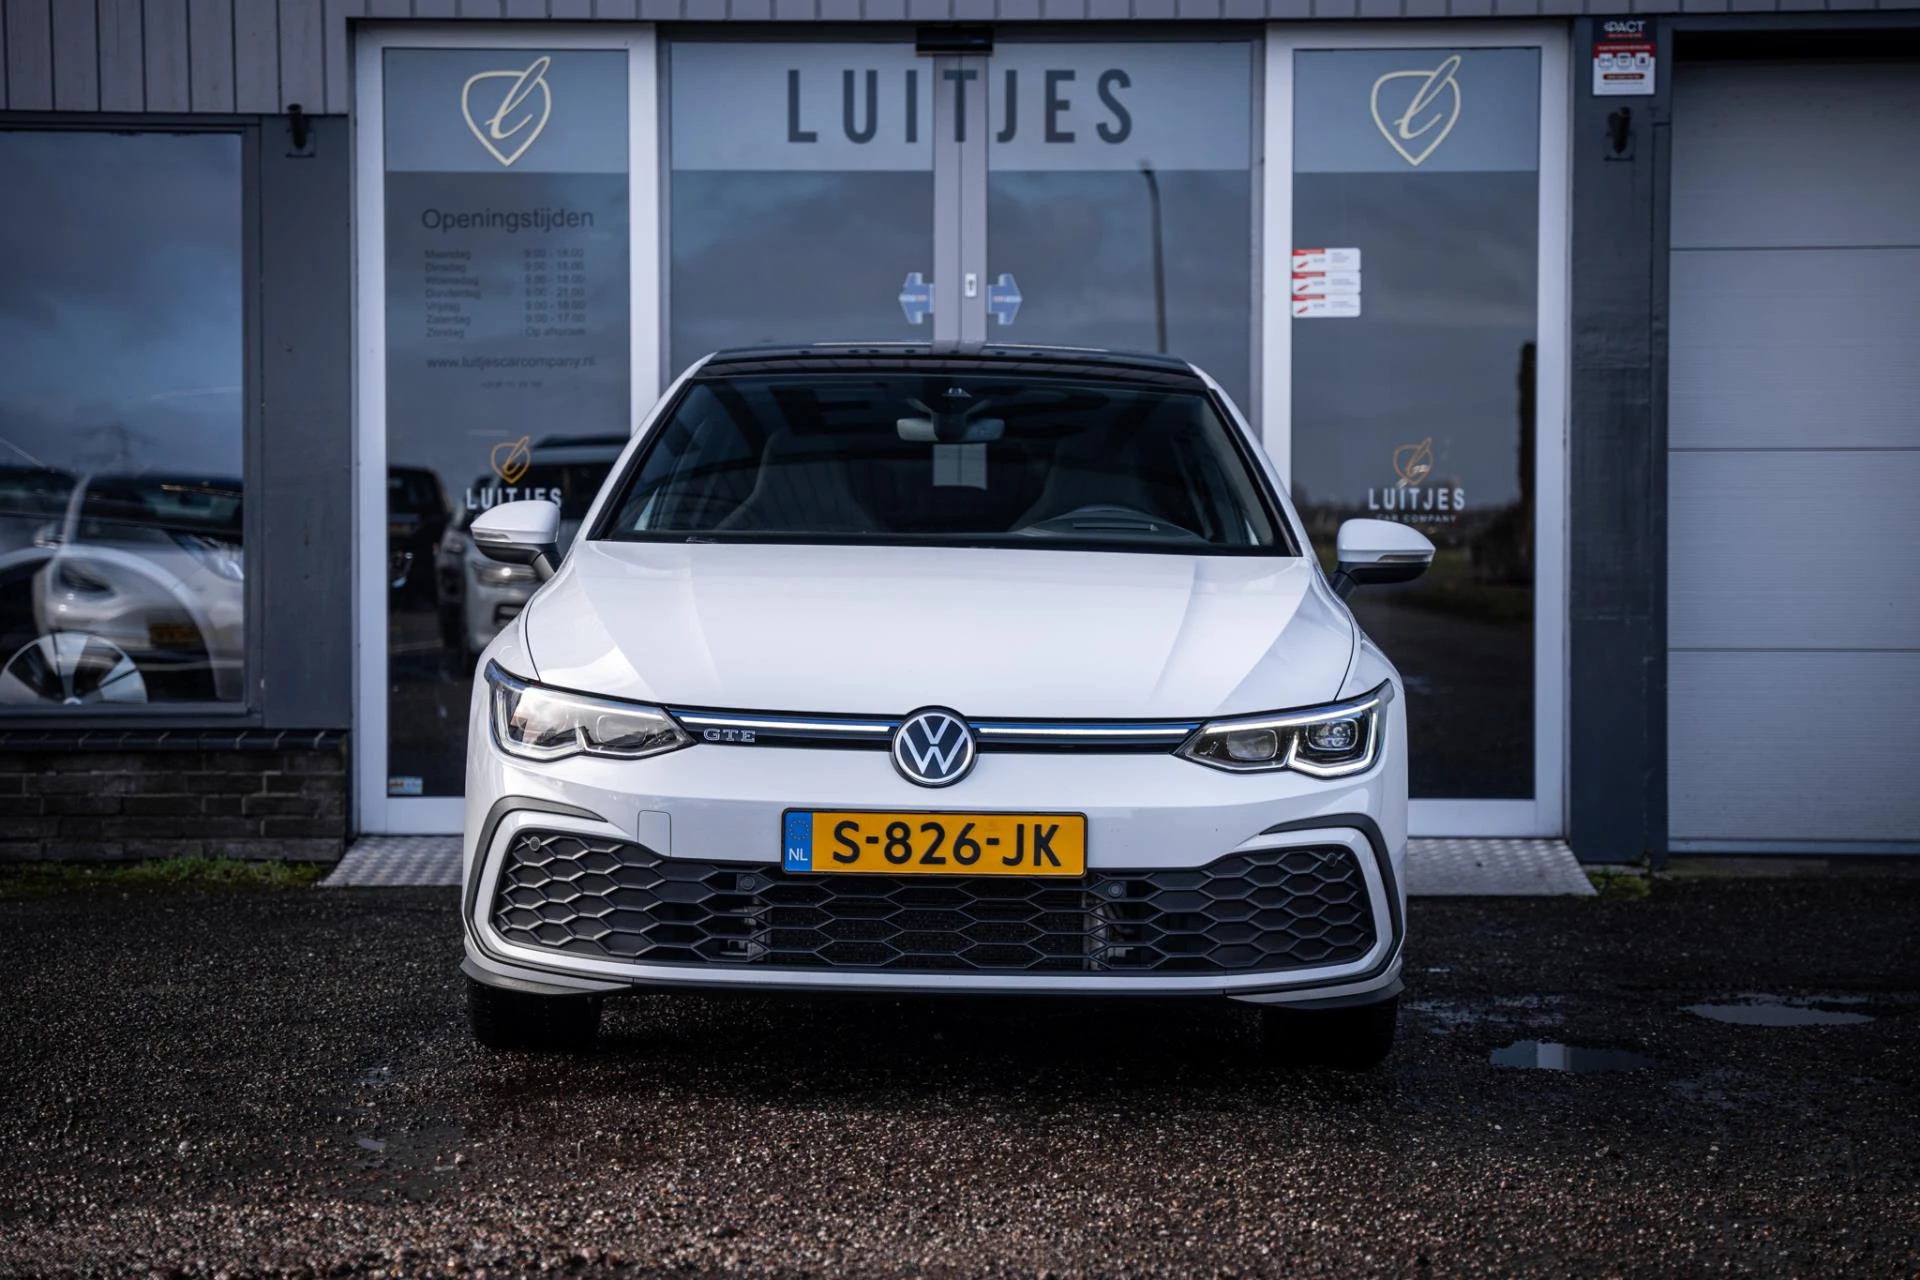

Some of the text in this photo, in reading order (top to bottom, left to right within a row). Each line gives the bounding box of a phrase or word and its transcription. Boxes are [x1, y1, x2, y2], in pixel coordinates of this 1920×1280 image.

[787, 68, 1132, 144] LUITJES
[421, 207, 594, 233] Openingstijden
[426, 355, 596, 371] www.luitjescarcompany.nl
[1368, 487, 1465, 511] LUITJES
[1403, 514, 1456, 523] COMPANY
[703, 728, 756, 743] GTE
[832, 820, 1062, 867] S-826-JK
[788, 848, 808, 862] NL
